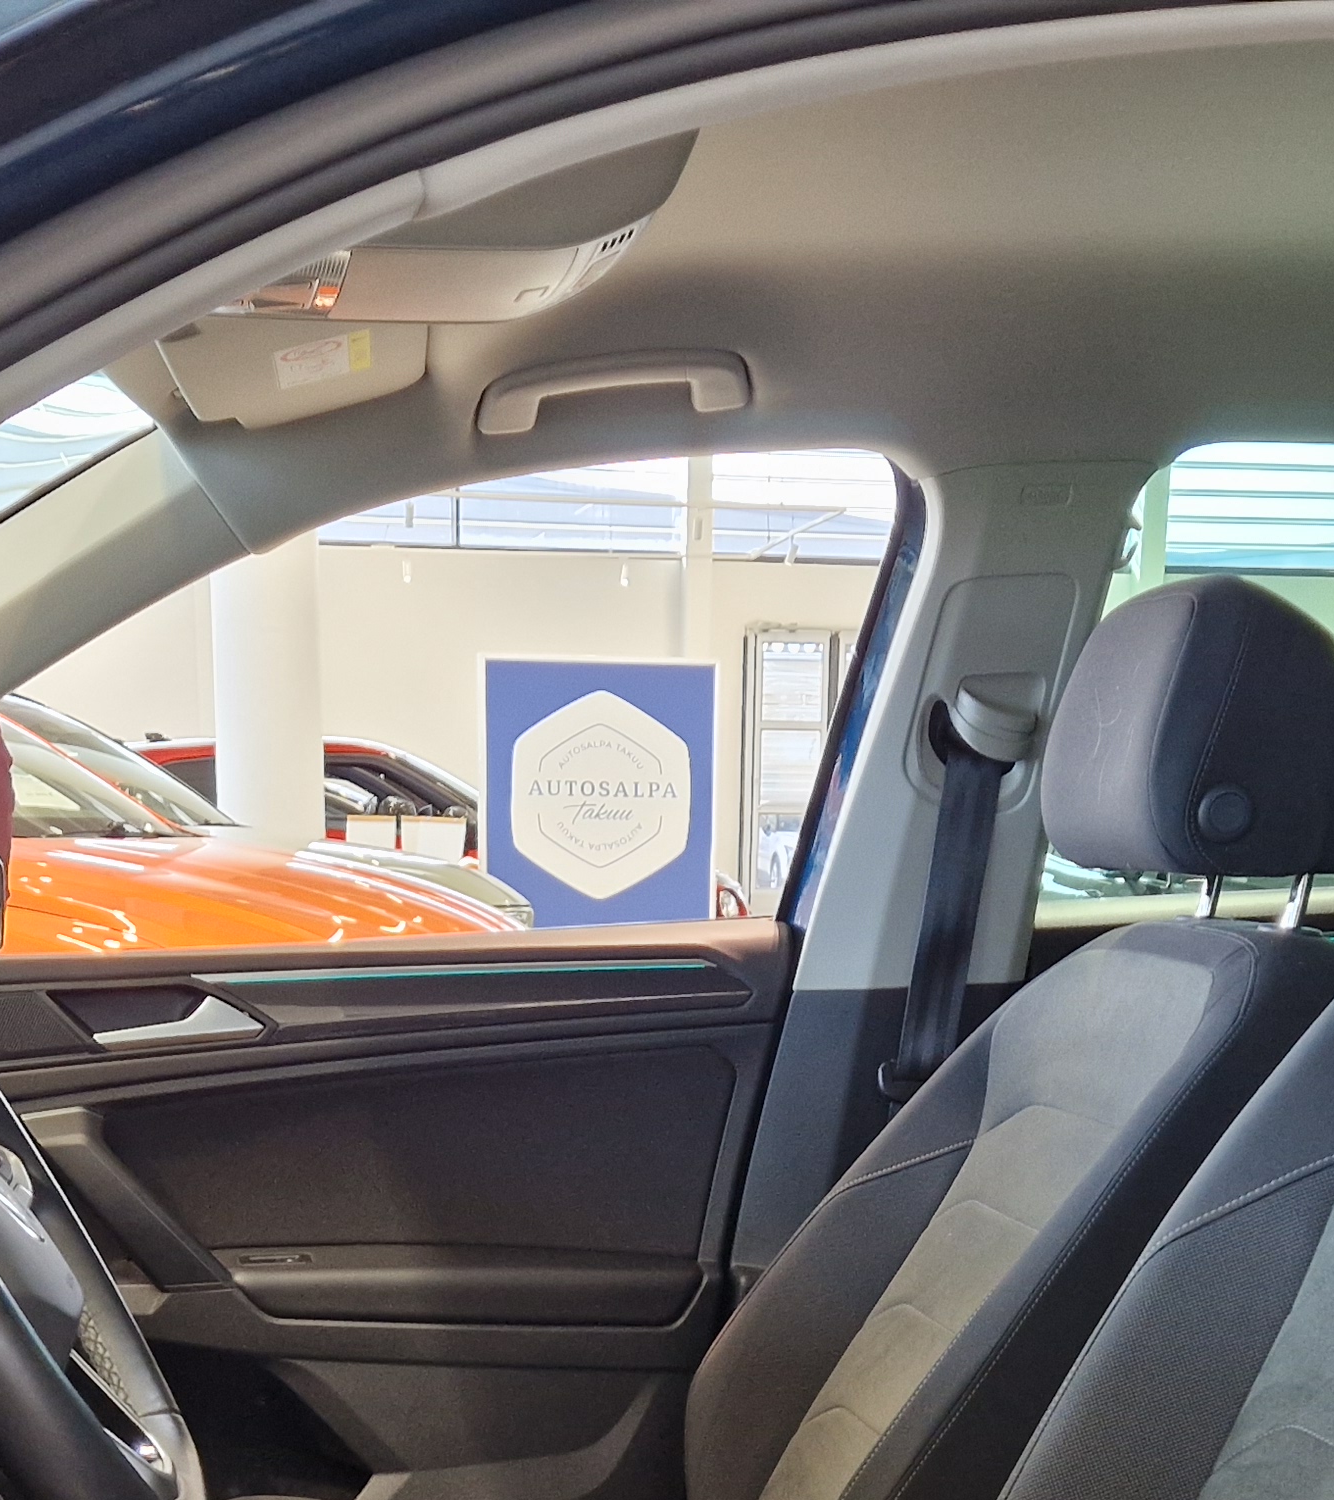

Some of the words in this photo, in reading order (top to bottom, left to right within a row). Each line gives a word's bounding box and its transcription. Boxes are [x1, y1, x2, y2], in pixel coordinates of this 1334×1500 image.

[557, 739, 613, 770] AUTOSALPA
[616, 743, 644, 770] TAKUU
[528, 779, 678, 798] AUTOSALPA
[563, 800, 634, 825] Takuu
[556, 821, 587, 848] TAKUU
[588, 822, 643, 851] AUTOSALPA
